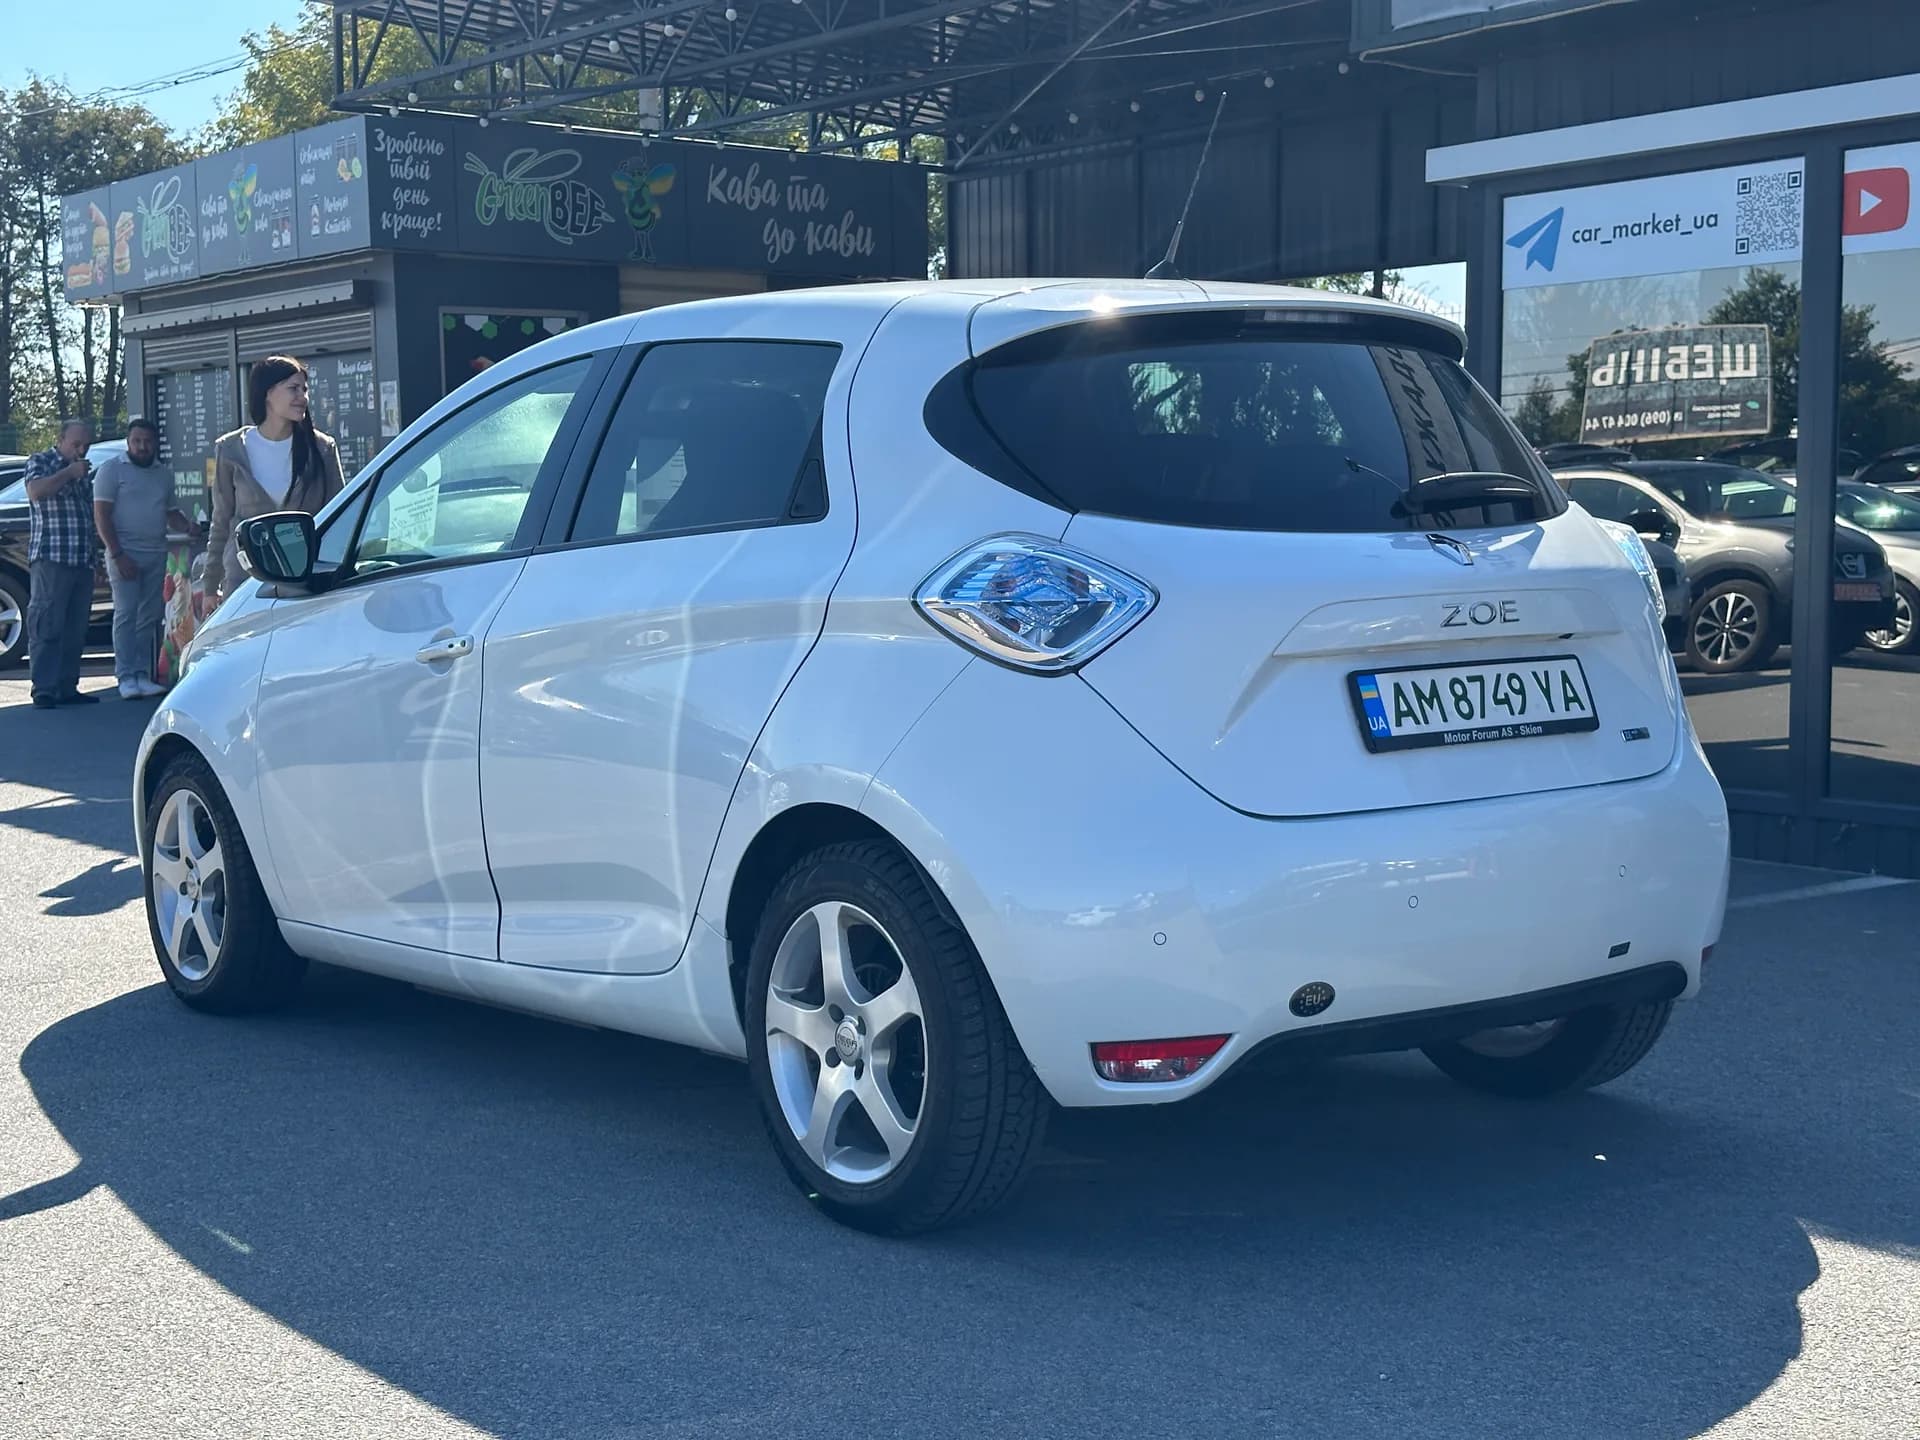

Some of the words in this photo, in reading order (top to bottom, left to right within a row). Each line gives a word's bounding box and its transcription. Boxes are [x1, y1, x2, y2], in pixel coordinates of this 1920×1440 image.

[374, 128, 444, 161] Зробимо
[390, 155, 431, 181] твій
[393, 186, 430, 211] день
[707, 162, 781, 211] Кава
[787, 175, 829, 213] та
[475, 171, 606, 236] GreenBEE
[381, 211, 442, 239] краще!
[763, 217, 797, 264] до
[804, 209, 876, 258] кави
[1572, 212, 1719, 245] car_market_ua
[1440, 600, 1520, 628] ZOE
[1393, 678, 1449, 728] AM
[1449, 671, 1527, 721] 8749
[1531, 669, 1586, 713] YA
[1368, 715, 1388, 732] UA
[1444, 731, 1471, 744] Motor
[1472, 728, 1500, 742] Forum
[1501, 726, 1514, 738] AS
[1519, 724, 1543, 736] Skien
[1306, 994, 1321, 1006] EU
